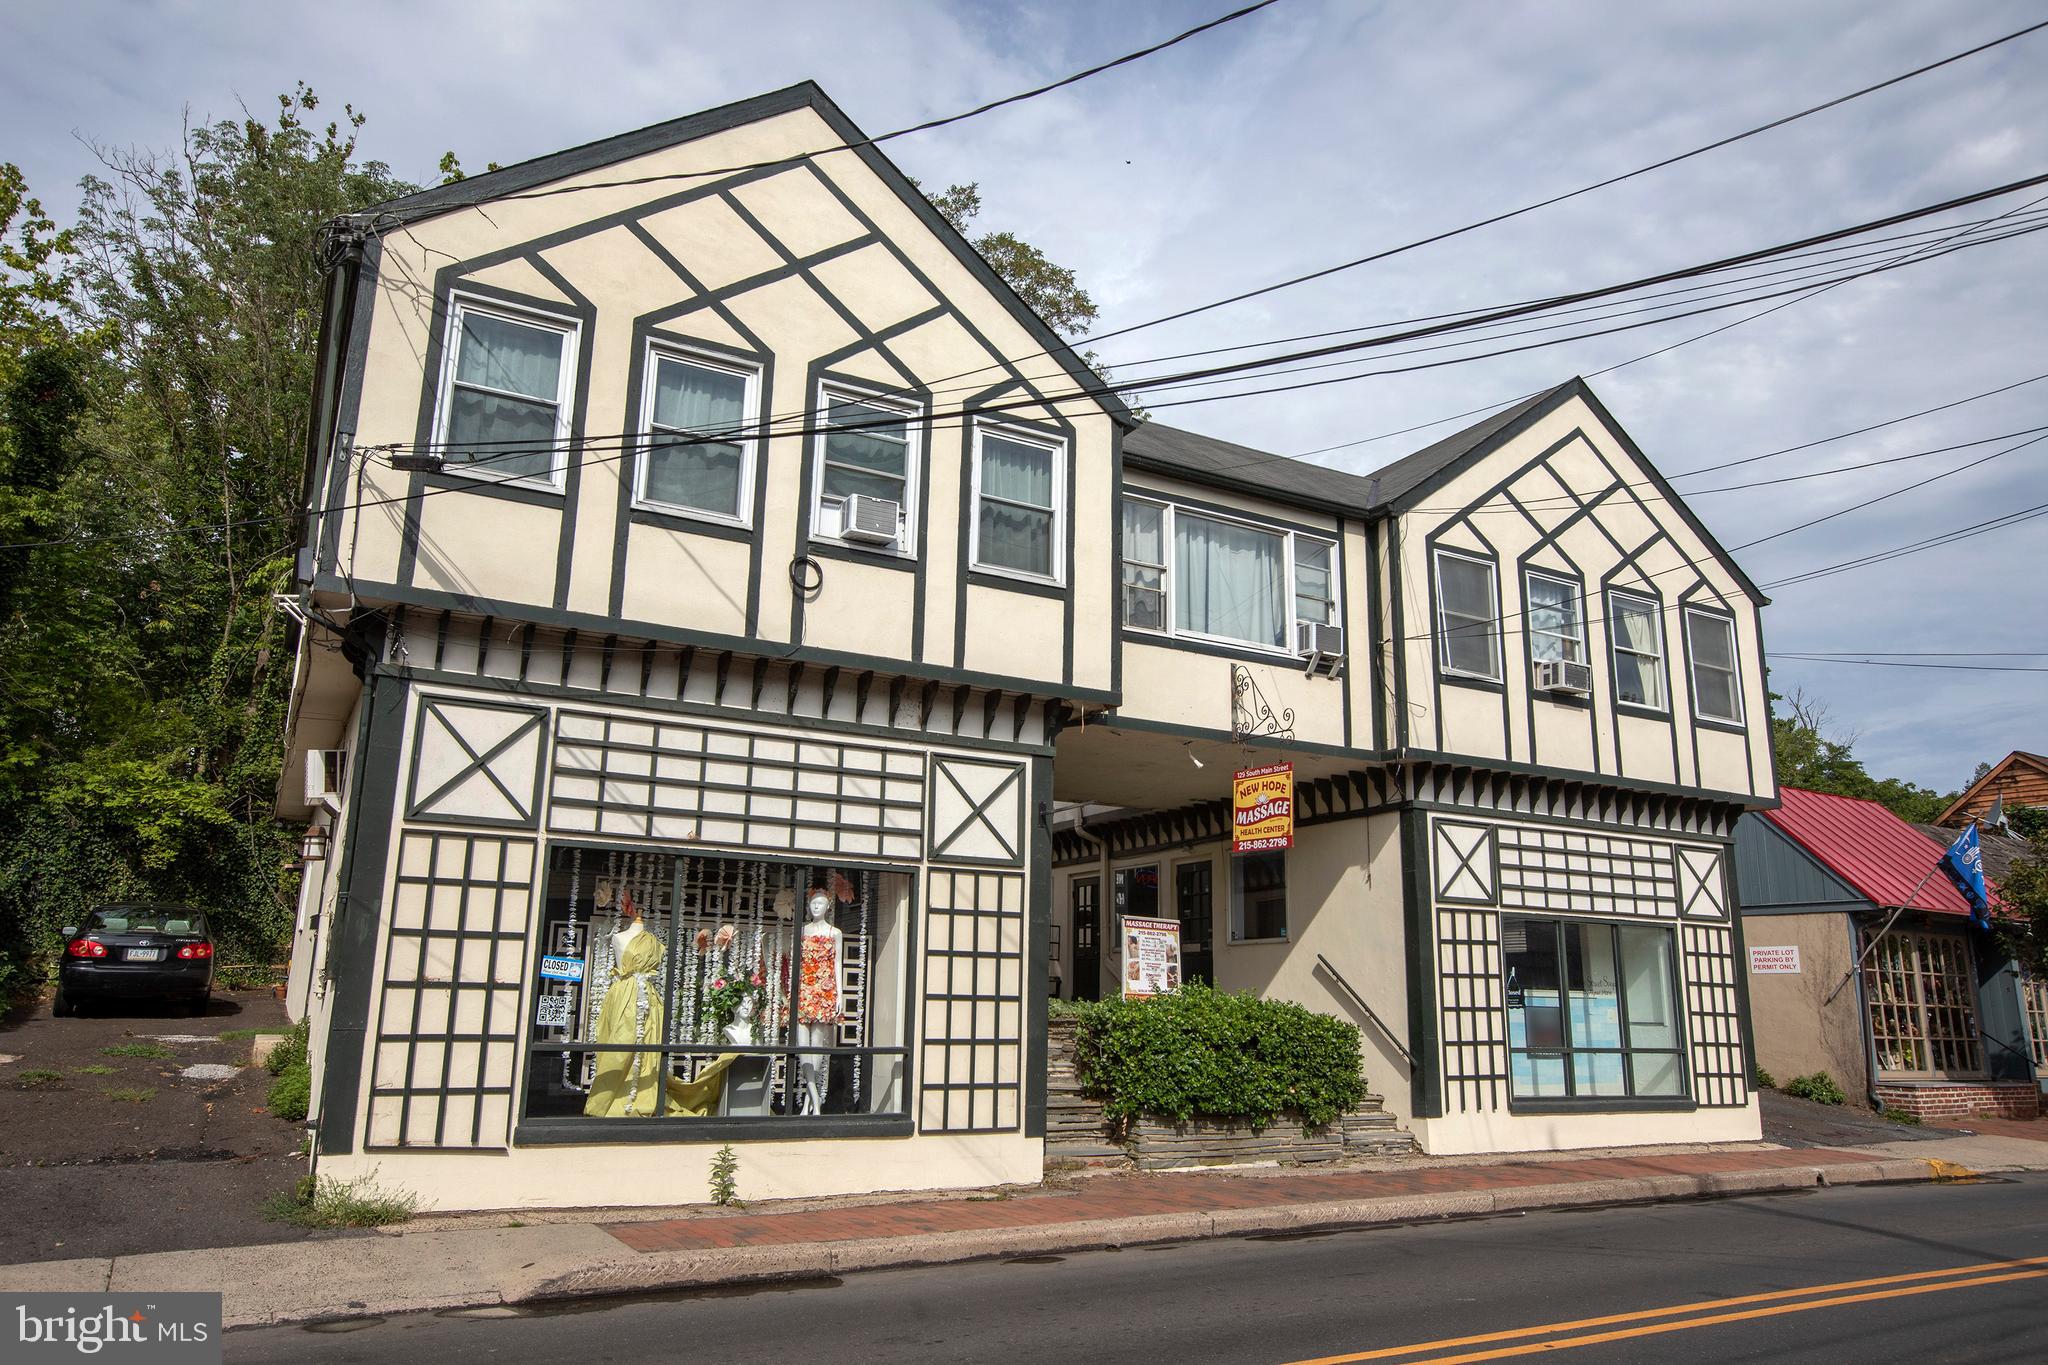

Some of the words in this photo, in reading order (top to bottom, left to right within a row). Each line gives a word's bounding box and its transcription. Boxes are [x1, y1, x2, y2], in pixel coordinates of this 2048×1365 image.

[1246, 768, 1260, 777] South
[1273, 764, 1289, 773] Street
[1240, 782, 1260, 800] NEW
[1262, 780, 1287, 794] HOPE
[1236, 801, 1290, 824] MASSAGE
[1240, 826, 1262, 836] HEALTH
[1263, 824, 1285, 834] CENTER
[1239, 837, 1287, 850] 215-862-2796
[1125, 920, 1152, 929] MASSAGE
[1153, 922, 1178, 930] THERAPY
[543, 959, 569, 971] CLOSED
